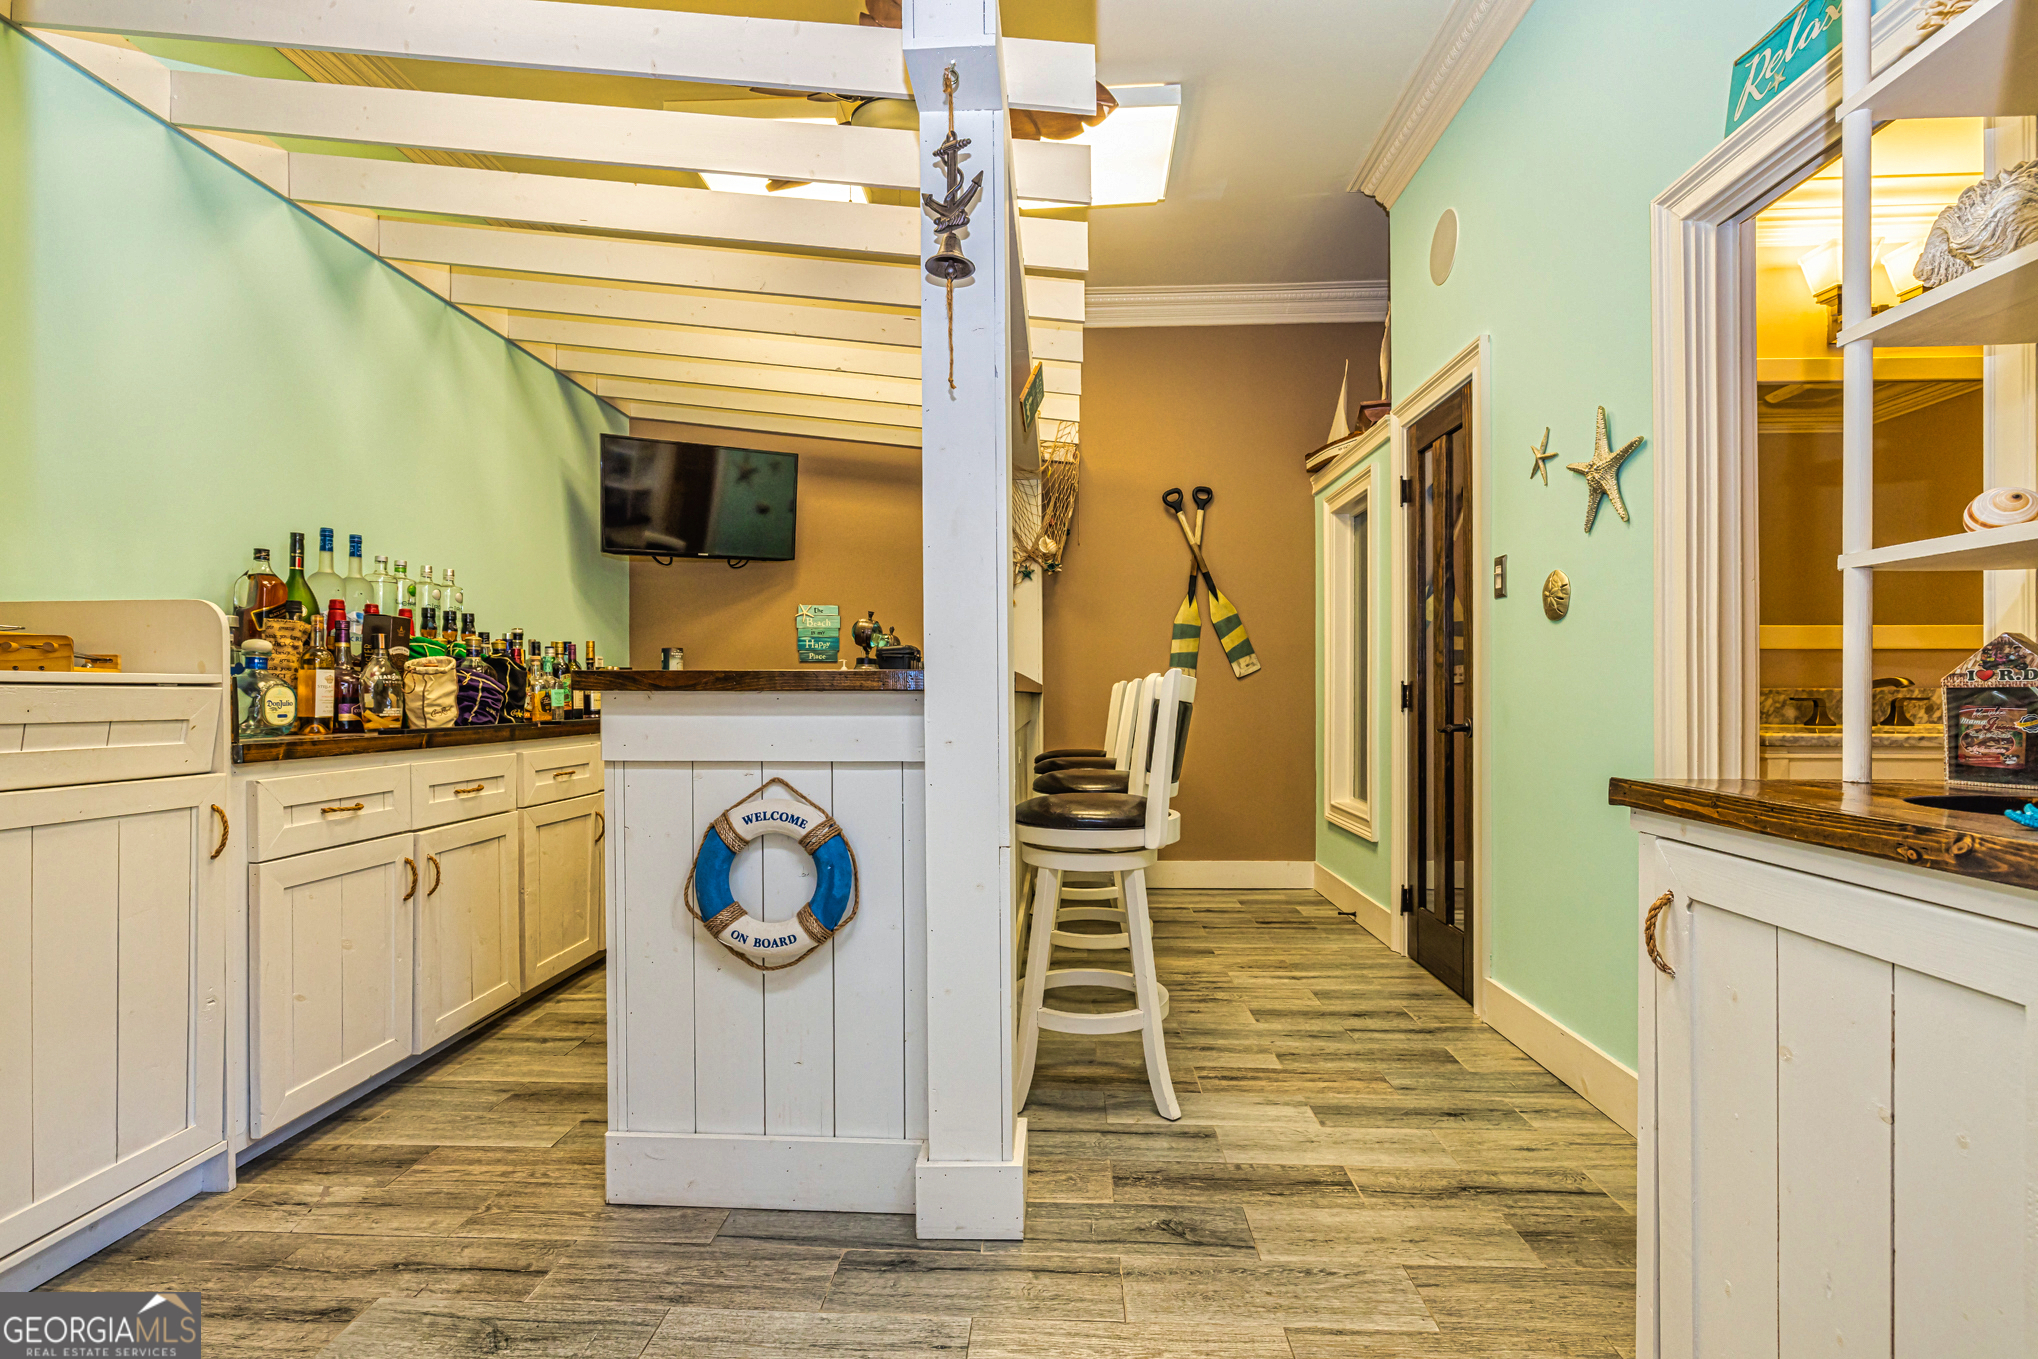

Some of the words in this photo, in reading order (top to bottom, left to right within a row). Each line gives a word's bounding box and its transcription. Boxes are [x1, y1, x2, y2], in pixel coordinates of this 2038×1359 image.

[806, 617, 831, 627] Beach
[805, 639, 830, 649] Happy
[1966, 669, 1976, 682] I
[741, 810, 809, 829] WELCOME
[730, 929, 749, 945] ON
[753, 933, 798, 949] BOARD
